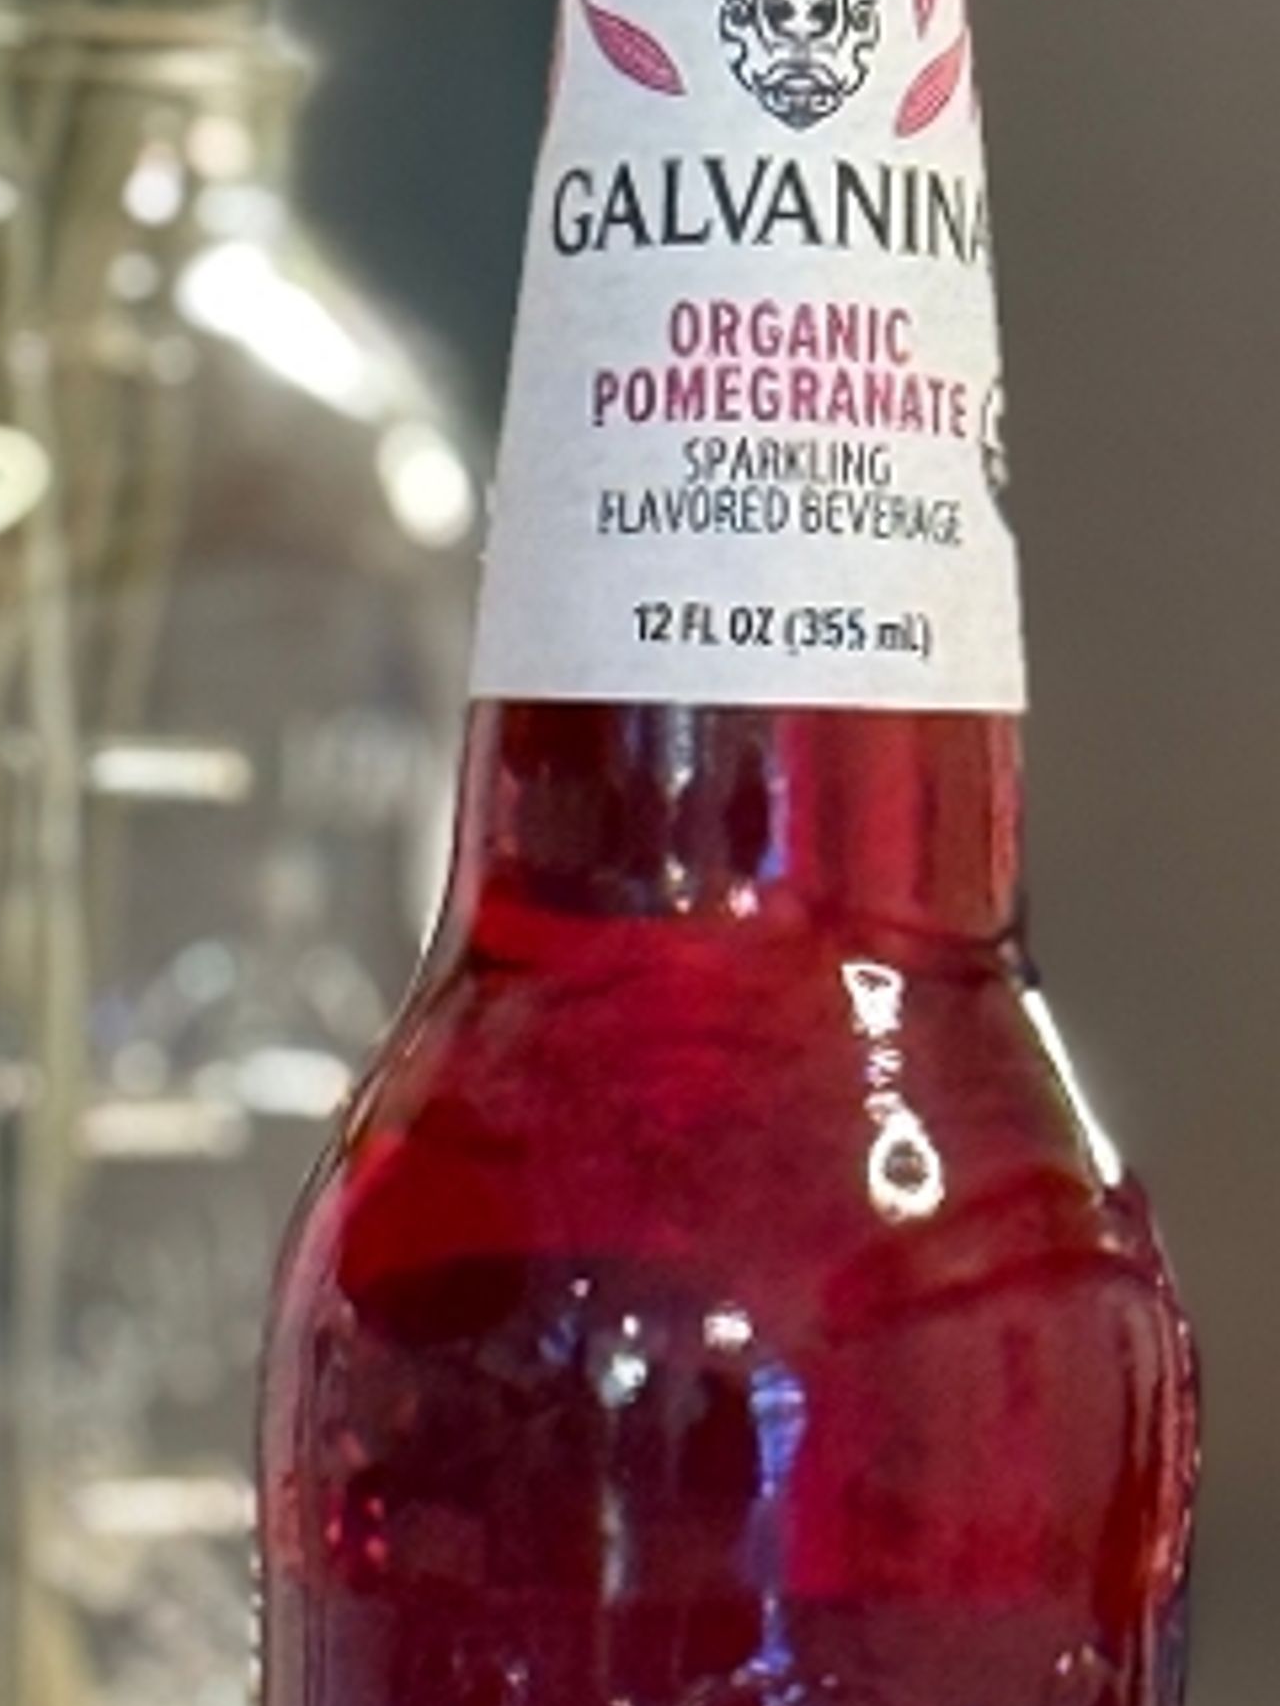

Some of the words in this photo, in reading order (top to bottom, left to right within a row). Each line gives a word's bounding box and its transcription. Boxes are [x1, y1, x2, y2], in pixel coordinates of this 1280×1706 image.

[669, 299, 913, 365] ORGANIC
[591, 366, 968, 439] POMEGRANATE
[683, 435, 892, 488] SPARKLING
[597, 485, 790, 536] FLAVORED
[800, 490, 963, 546] BEVERAGE
[633, 602, 672, 643] 12
[681, 603, 718, 645] FL
[729, 606, 774, 646] OZ
[783, 605, 867, 657] (355
